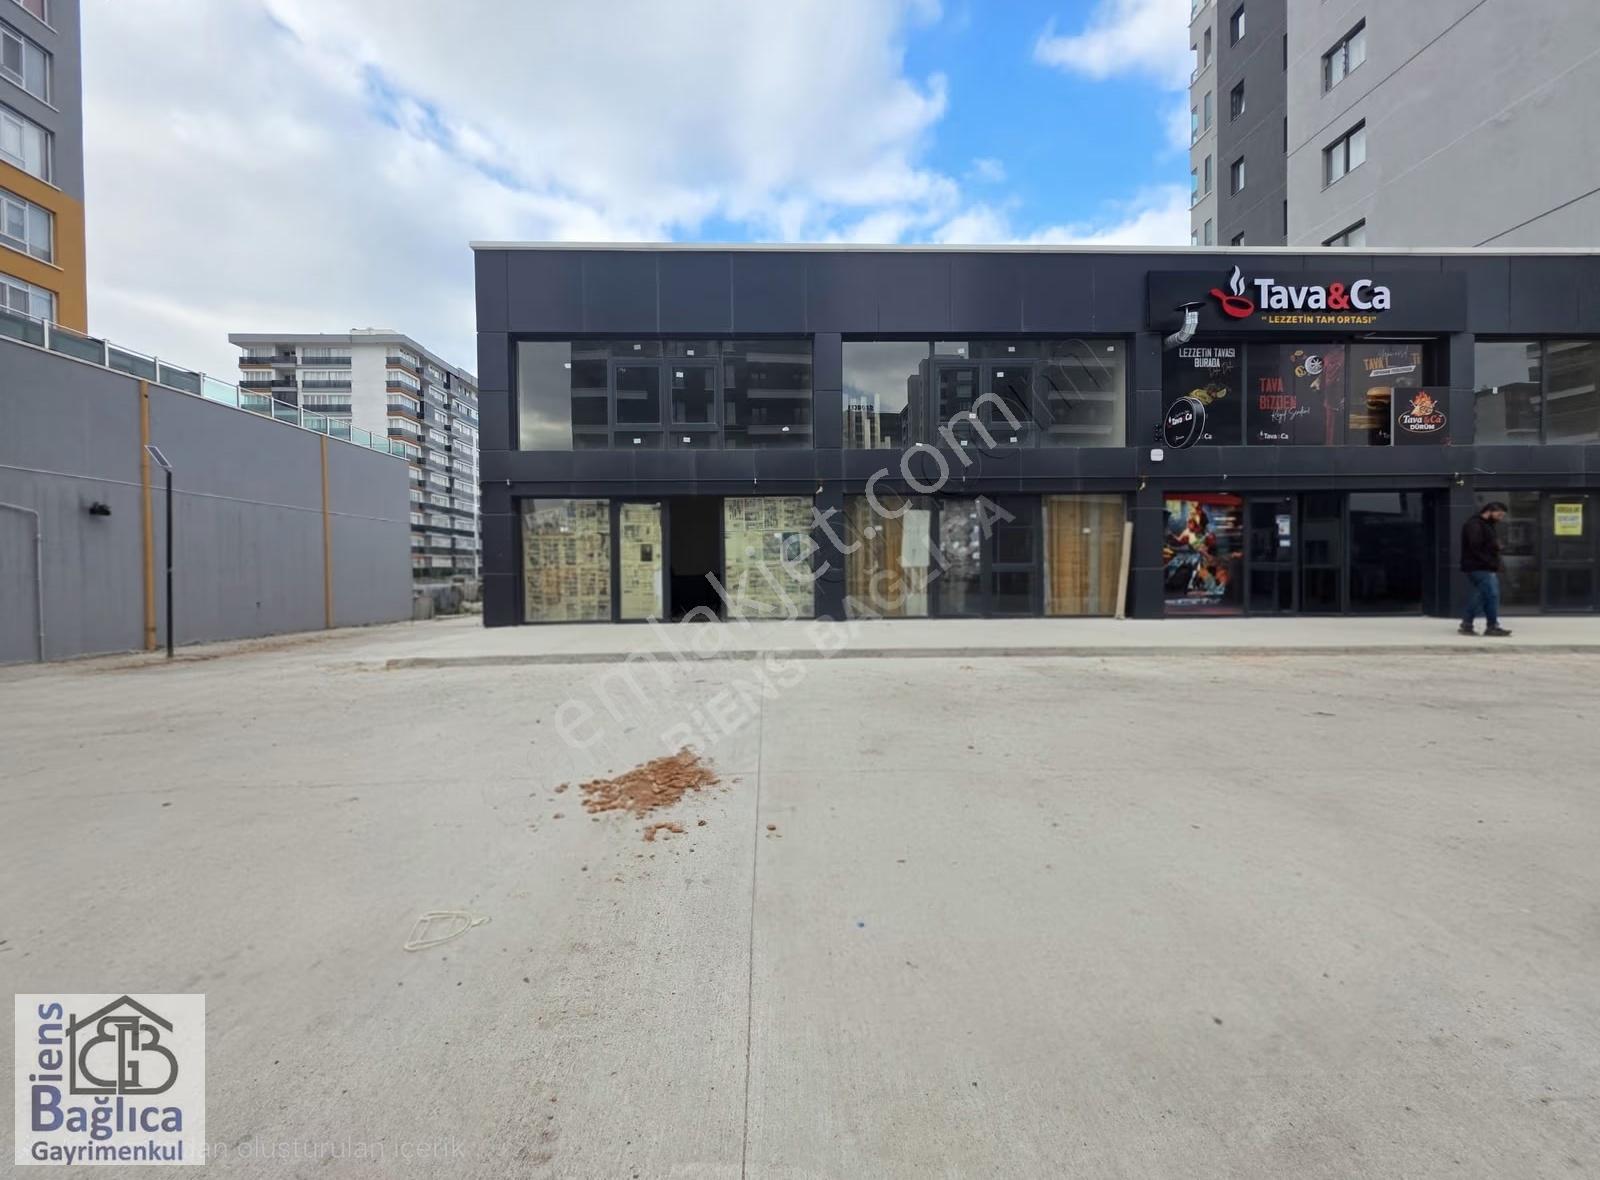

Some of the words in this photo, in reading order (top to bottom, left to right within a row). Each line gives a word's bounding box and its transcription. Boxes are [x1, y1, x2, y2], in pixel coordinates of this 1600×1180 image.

[1254, 278, 1391, 309] Tava&Ca
[1316, 316, 1336, 324] TAM
[1214, 347, 1236, 358] TAVASI
[1194, 358, 1221, 368] BURADA
[1259, 378, 1284, 393] TAVA
